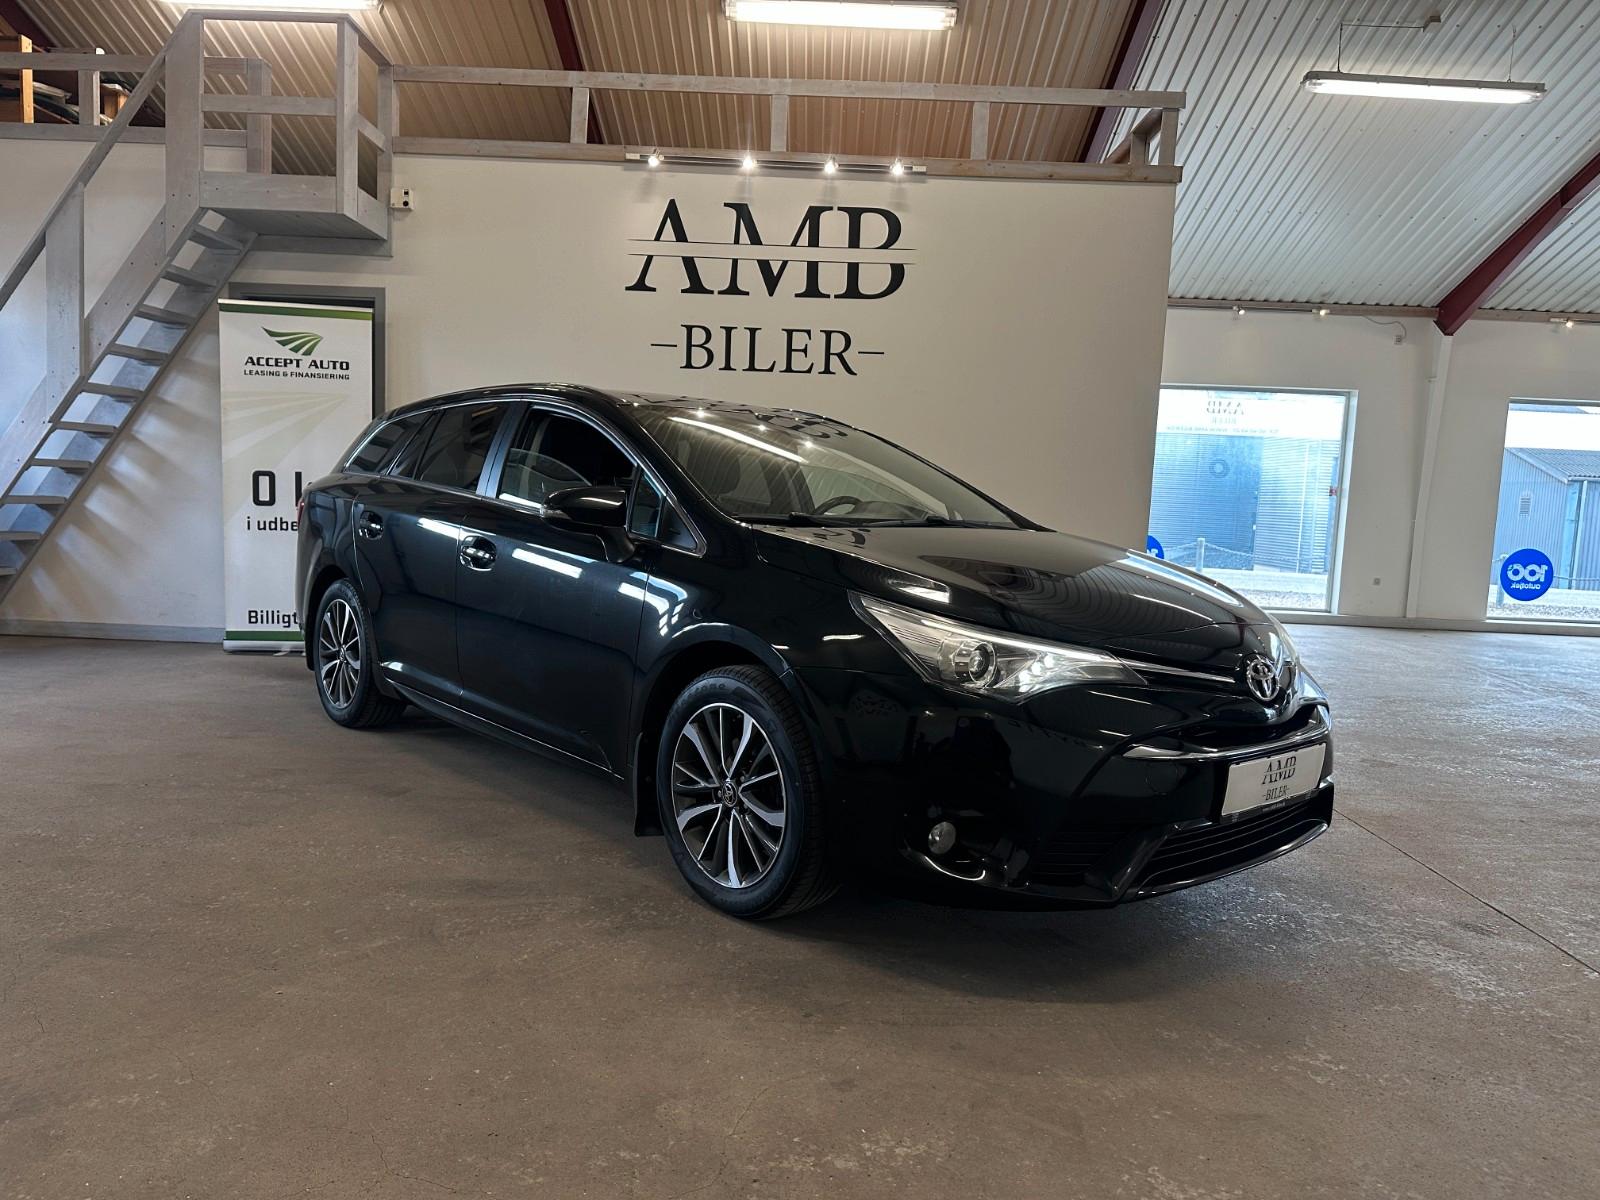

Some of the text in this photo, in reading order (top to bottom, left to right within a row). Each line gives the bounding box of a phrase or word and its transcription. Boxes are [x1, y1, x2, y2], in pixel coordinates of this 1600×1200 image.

[625, 198, 905, 300] AMB
[244, 356, 350, 371] ACCEPT AUTO
[243, 369, 281, 377] LEASING
[290, 371, 350, 380] FINANSIERING
[246, 516, 298, 531] i udbe
[248, 610, 298, 628] Billigt
[1262, 756, 1297, 784] AMB
